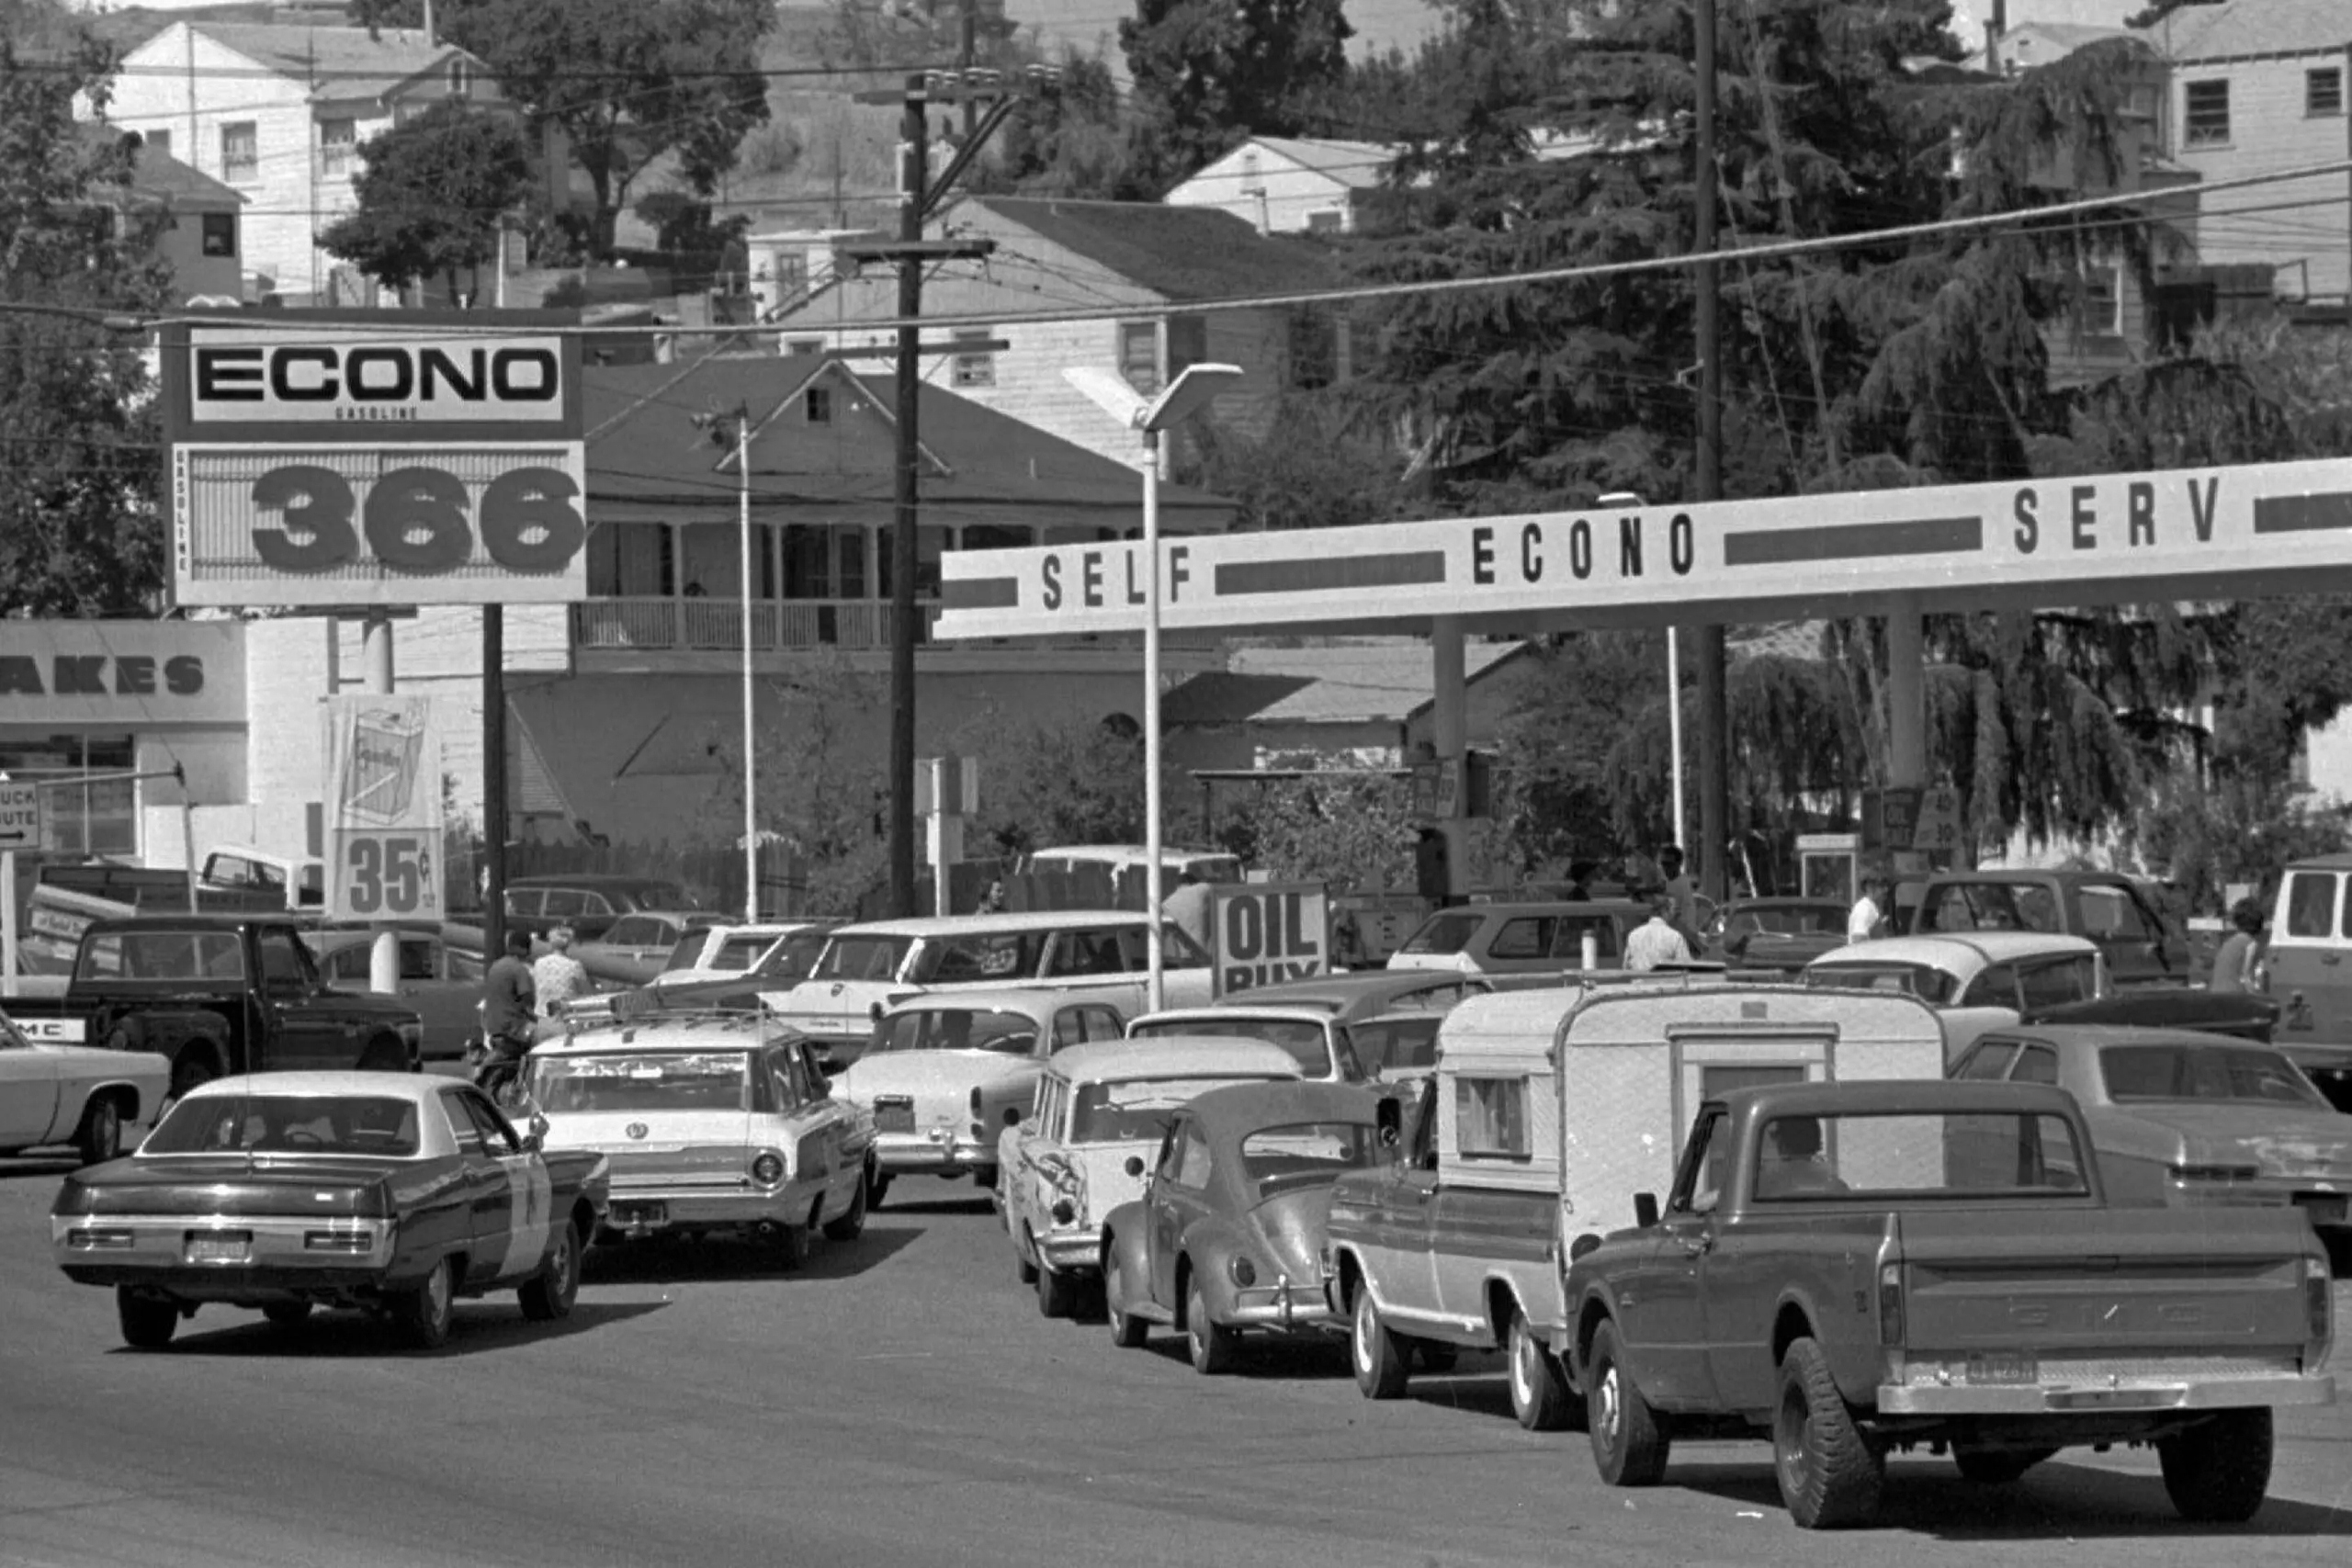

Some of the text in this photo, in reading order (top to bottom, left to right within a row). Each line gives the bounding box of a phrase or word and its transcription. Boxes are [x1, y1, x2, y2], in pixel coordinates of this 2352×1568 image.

[198, 347, 558, 401] ECONO
[252, 465, 586, 575] 366
[1042, 476, 2219, 609] SELF ECONO SERV
[0, 655, 205, 695] AKES
[1227, 893, 1318, 960] OIL
[17, 1022, 62, 1037] MC
